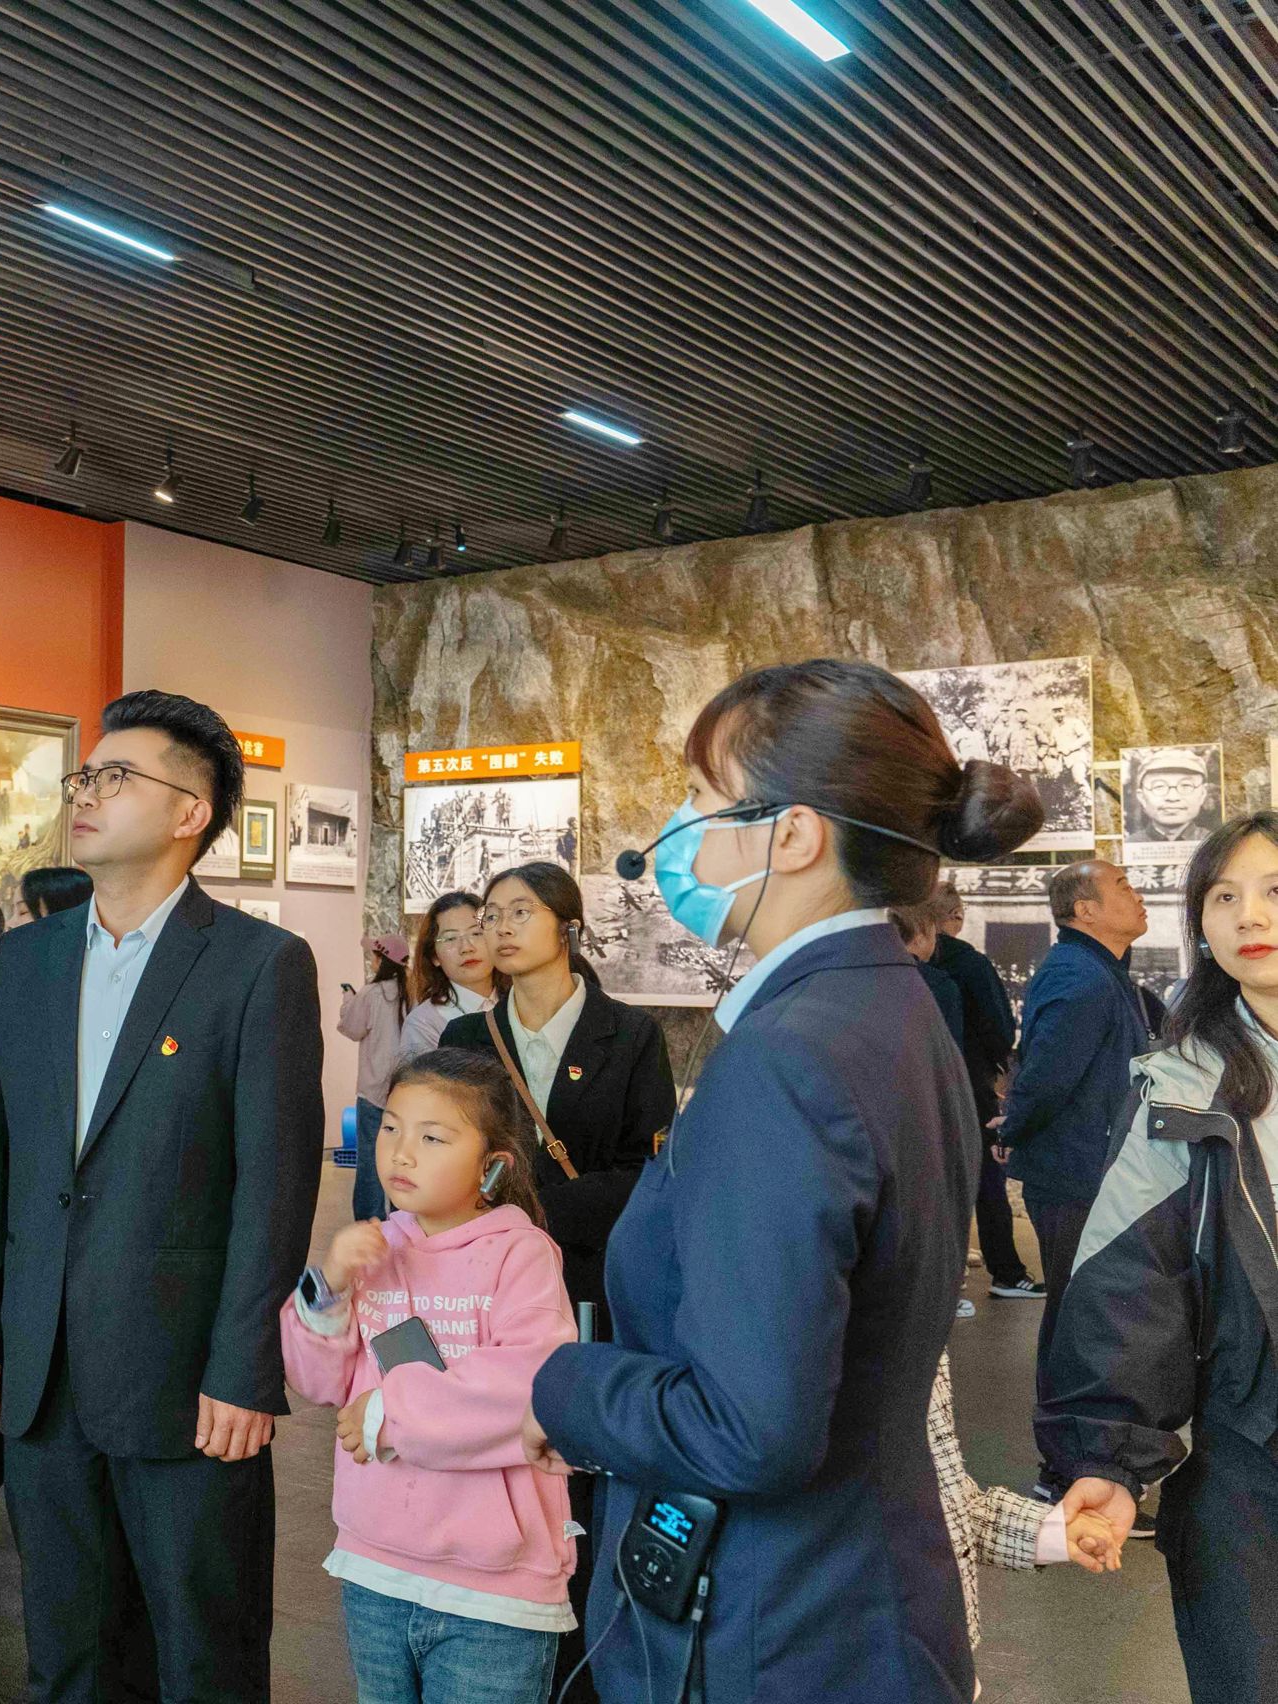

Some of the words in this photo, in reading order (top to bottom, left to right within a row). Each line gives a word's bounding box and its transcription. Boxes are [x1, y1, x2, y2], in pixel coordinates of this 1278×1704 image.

[413, 1295, 430, 1311] TO
[357, 1301, 383, 1323] WE
[428, 1319, 478, 1336] HANGE
